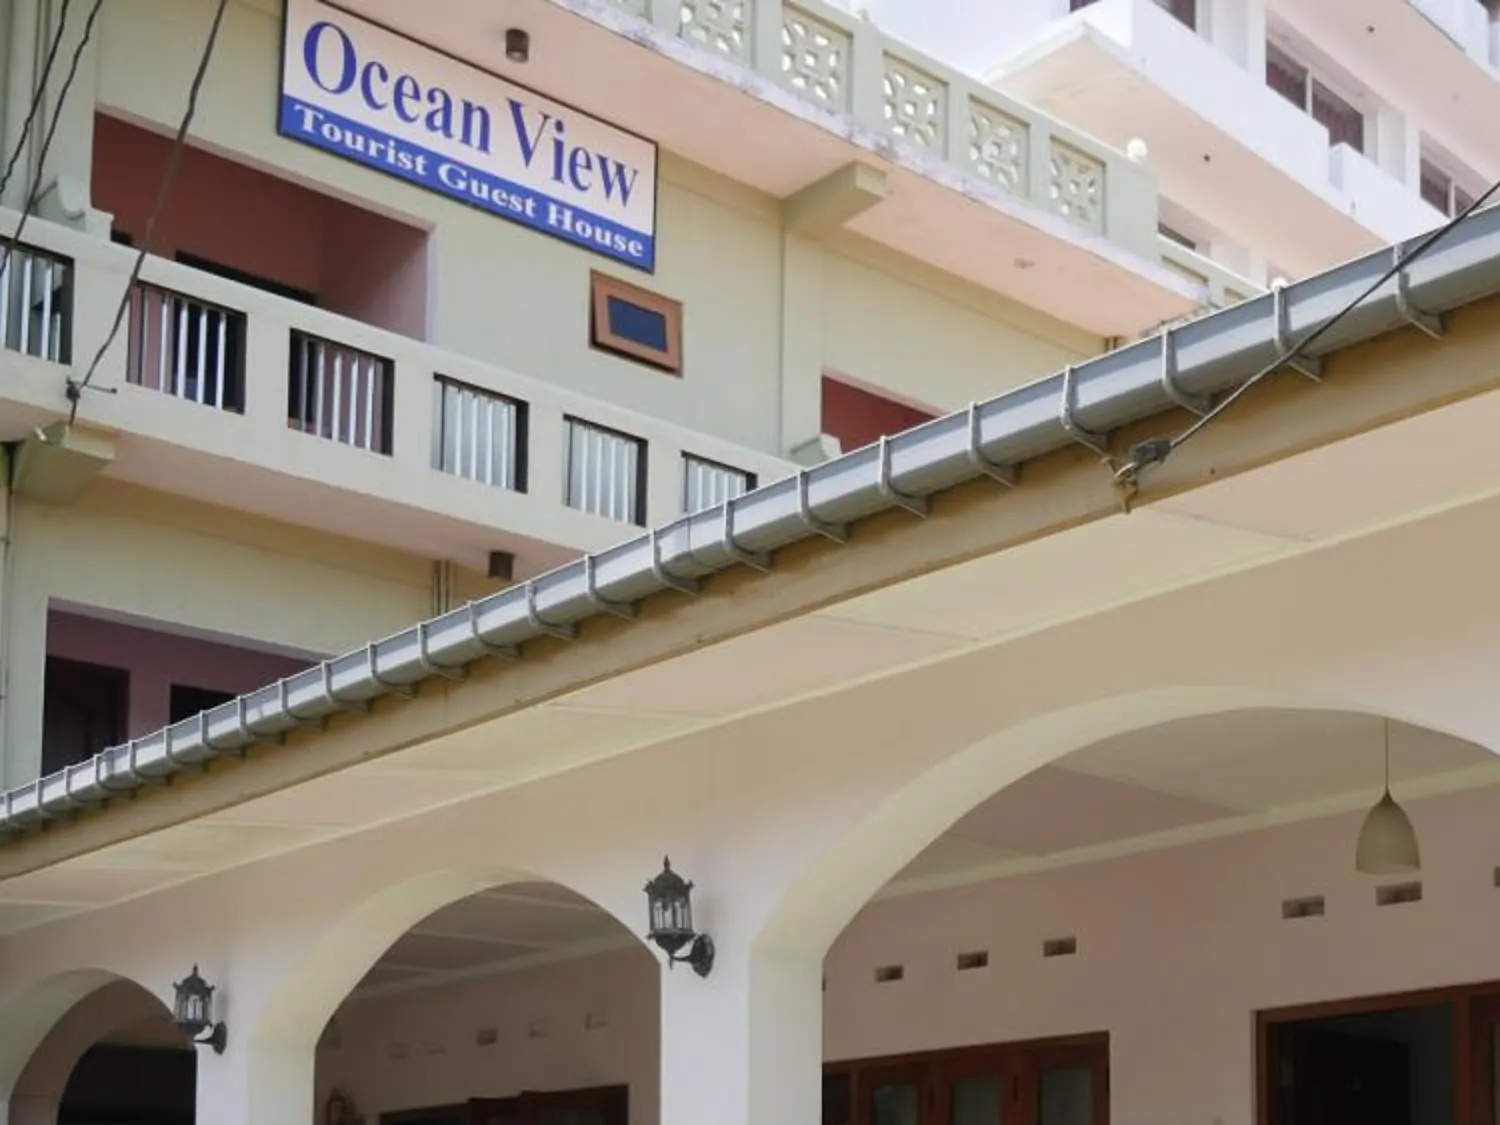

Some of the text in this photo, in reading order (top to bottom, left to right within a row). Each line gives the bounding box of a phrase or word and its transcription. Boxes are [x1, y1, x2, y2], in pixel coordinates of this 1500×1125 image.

[294, 105, 643, 258] Tourist Guest House
[303, 21, 639, 208] Ocean View
